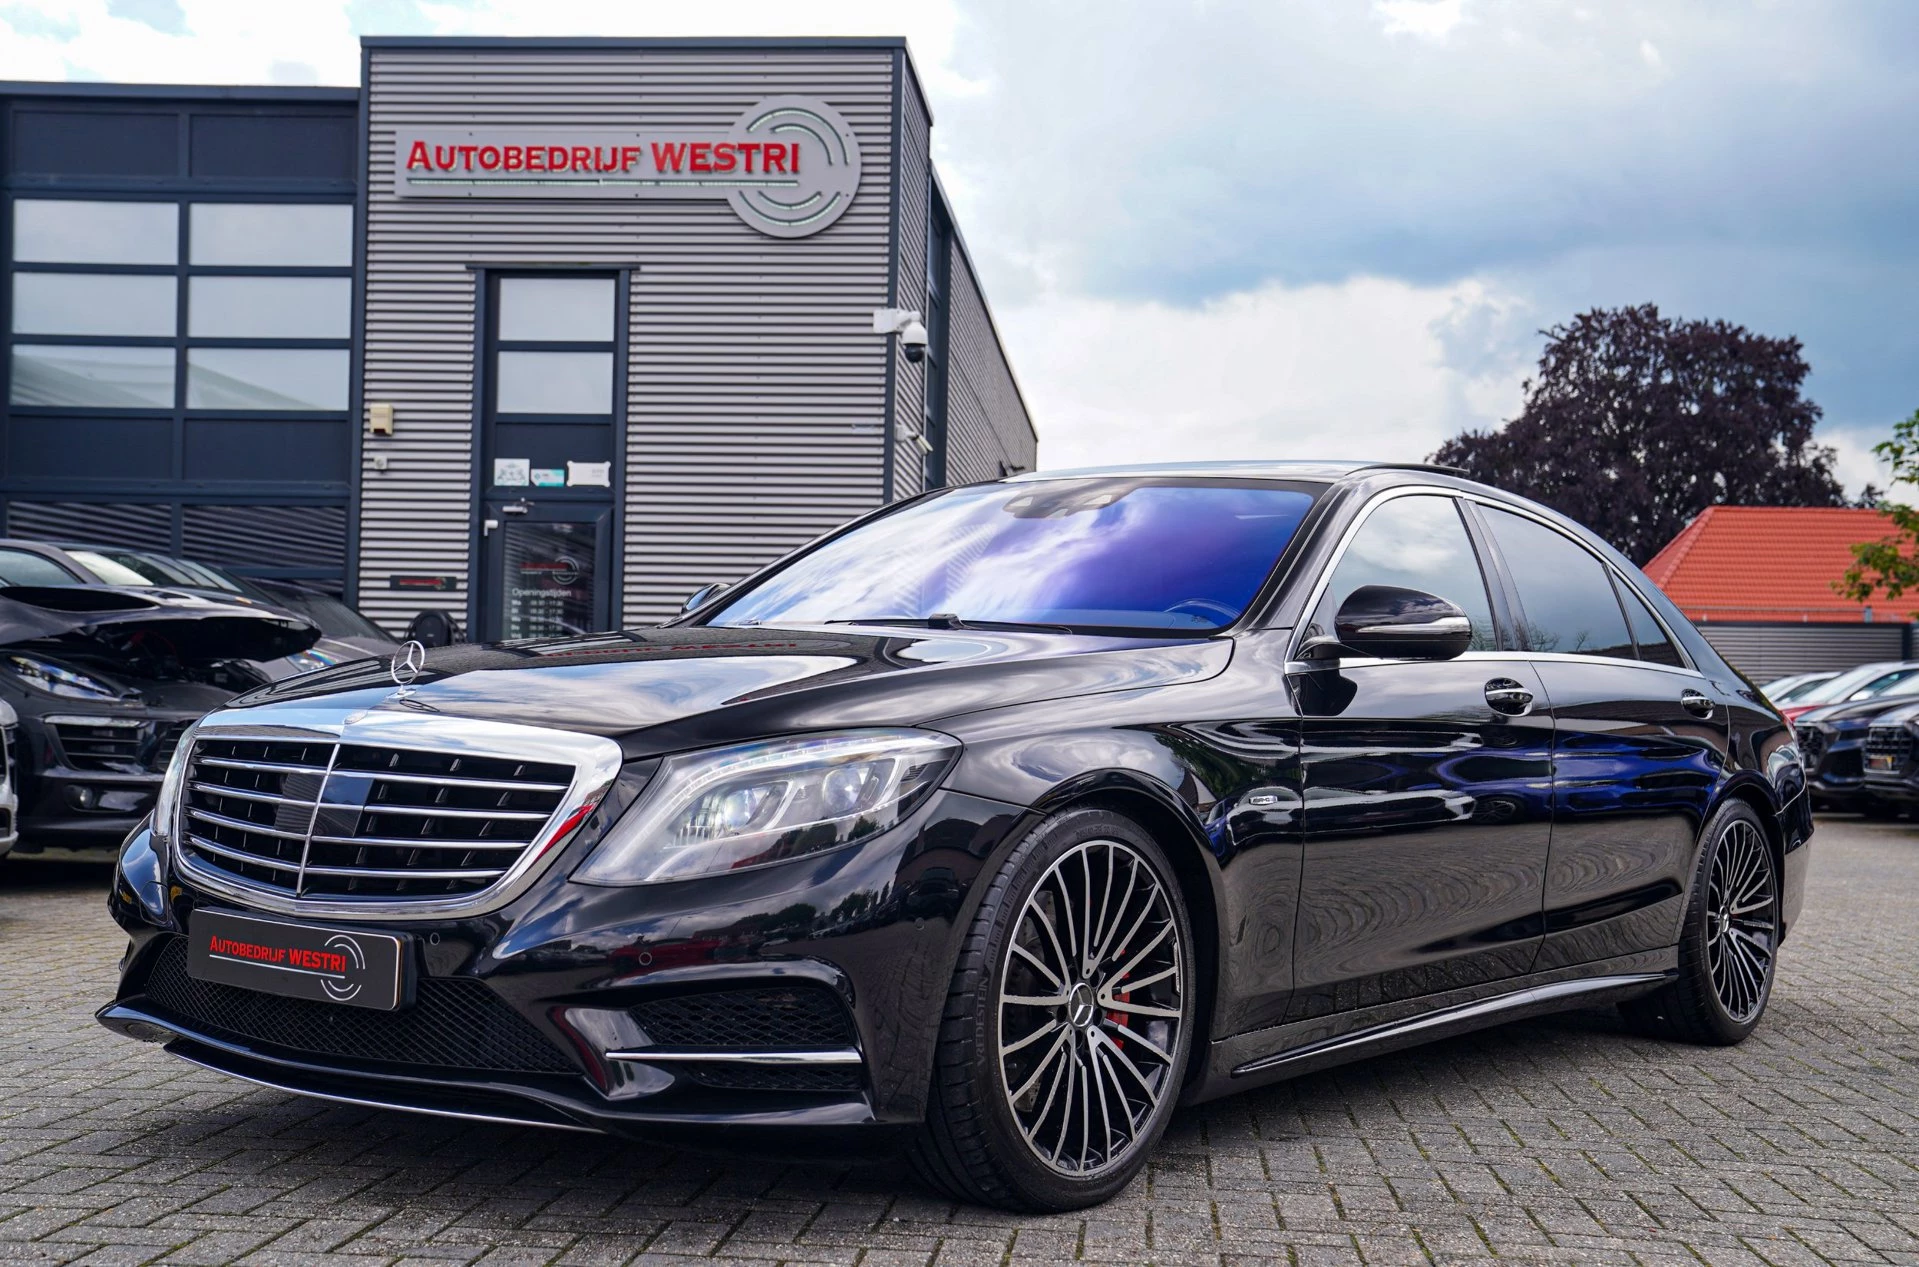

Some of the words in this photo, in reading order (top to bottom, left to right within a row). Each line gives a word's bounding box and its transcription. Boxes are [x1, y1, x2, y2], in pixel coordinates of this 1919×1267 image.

[406, 140, 642, 173] AUTOBEDRIJF
[651, 142, 801, 174] WESTRI
[512, 588, 572, 598] Openingstijden
[209, 935, 286, 963] AUTOBEDRIJF
[288, 948, 347, 972] WESTRI
[976, 977, 989, 1067] VREDESTEIN
